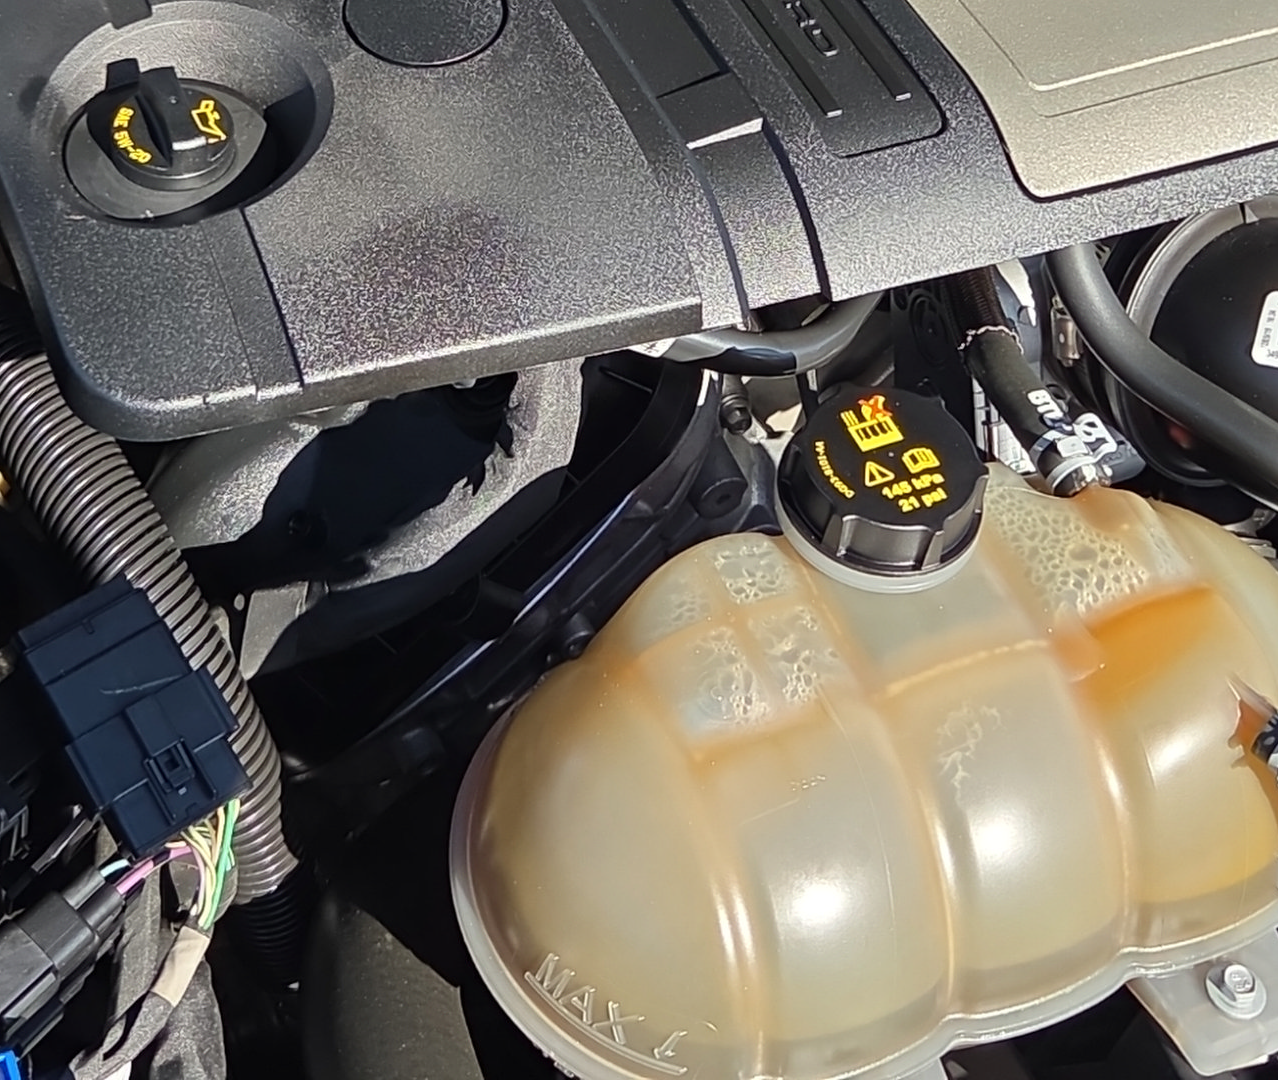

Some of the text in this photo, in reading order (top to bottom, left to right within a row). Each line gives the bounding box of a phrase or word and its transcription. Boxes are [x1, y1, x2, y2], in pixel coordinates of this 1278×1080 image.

[113, 107, 153, 163] SAE 5W-20
[882, 473, 945, 500] 145 kPa
[898, 488, 948, 513] 21 psi
[535, 952, 646, 1045] MAX
